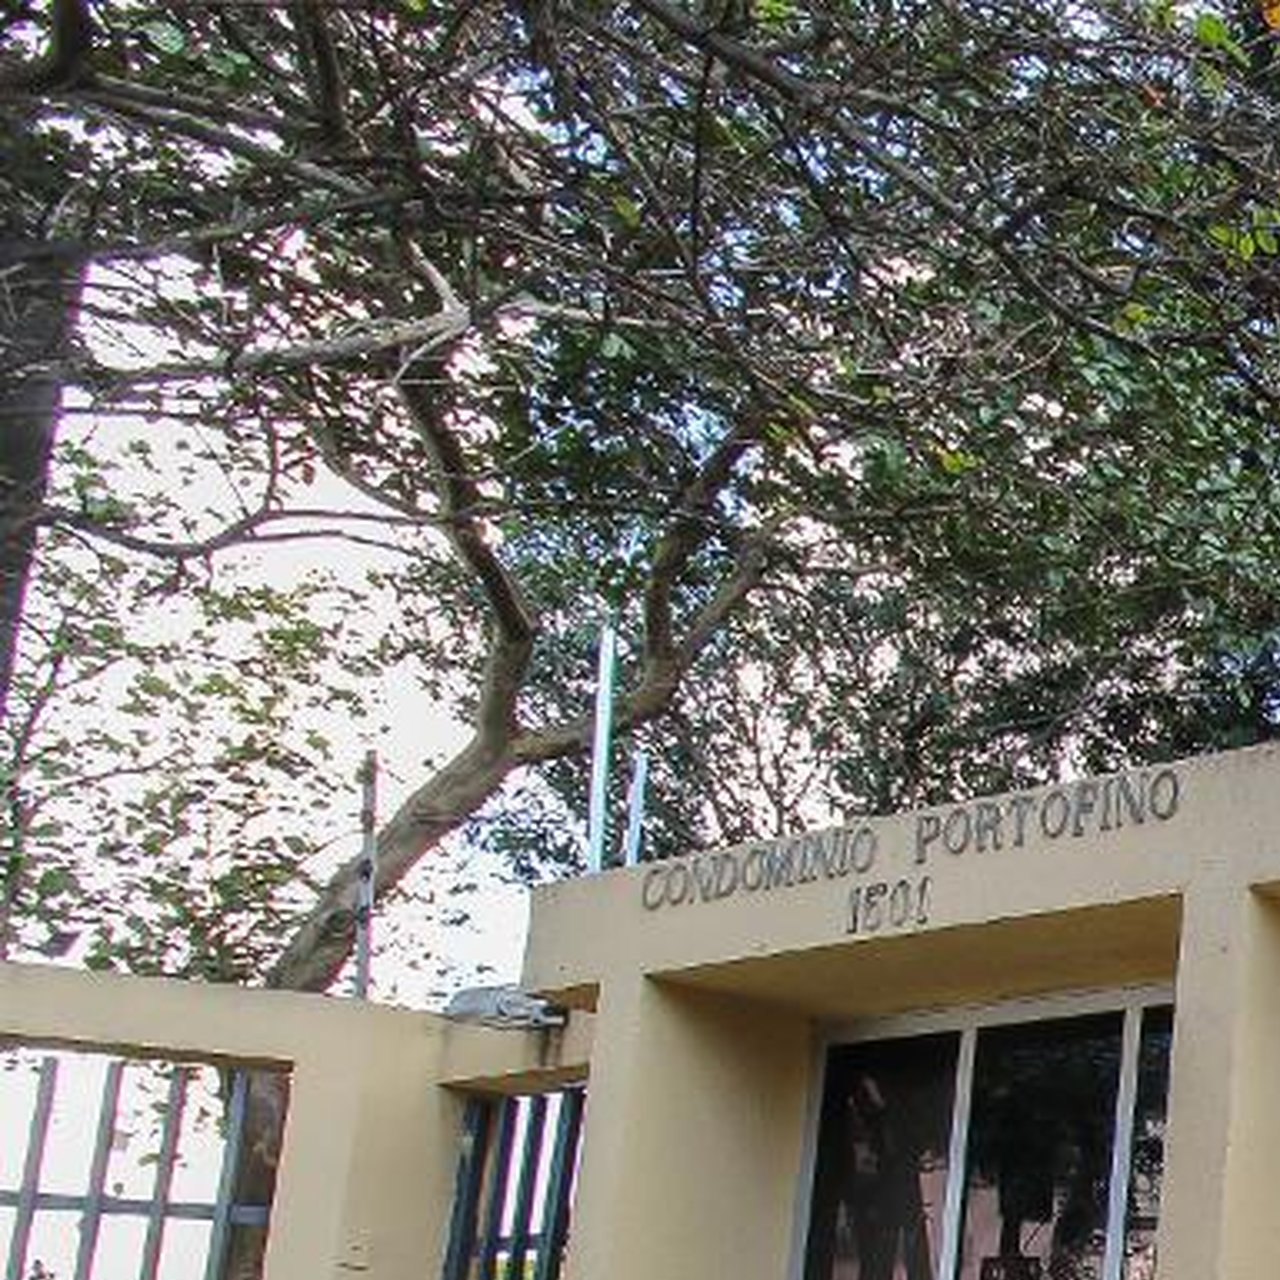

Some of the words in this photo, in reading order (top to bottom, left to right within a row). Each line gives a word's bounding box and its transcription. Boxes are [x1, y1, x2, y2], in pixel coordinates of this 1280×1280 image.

[643, 826, 877, 911] CONDOMINIO
[915, 769, 1180, 864] PORTOFINO
[847, 876, 930, 934] 1501
